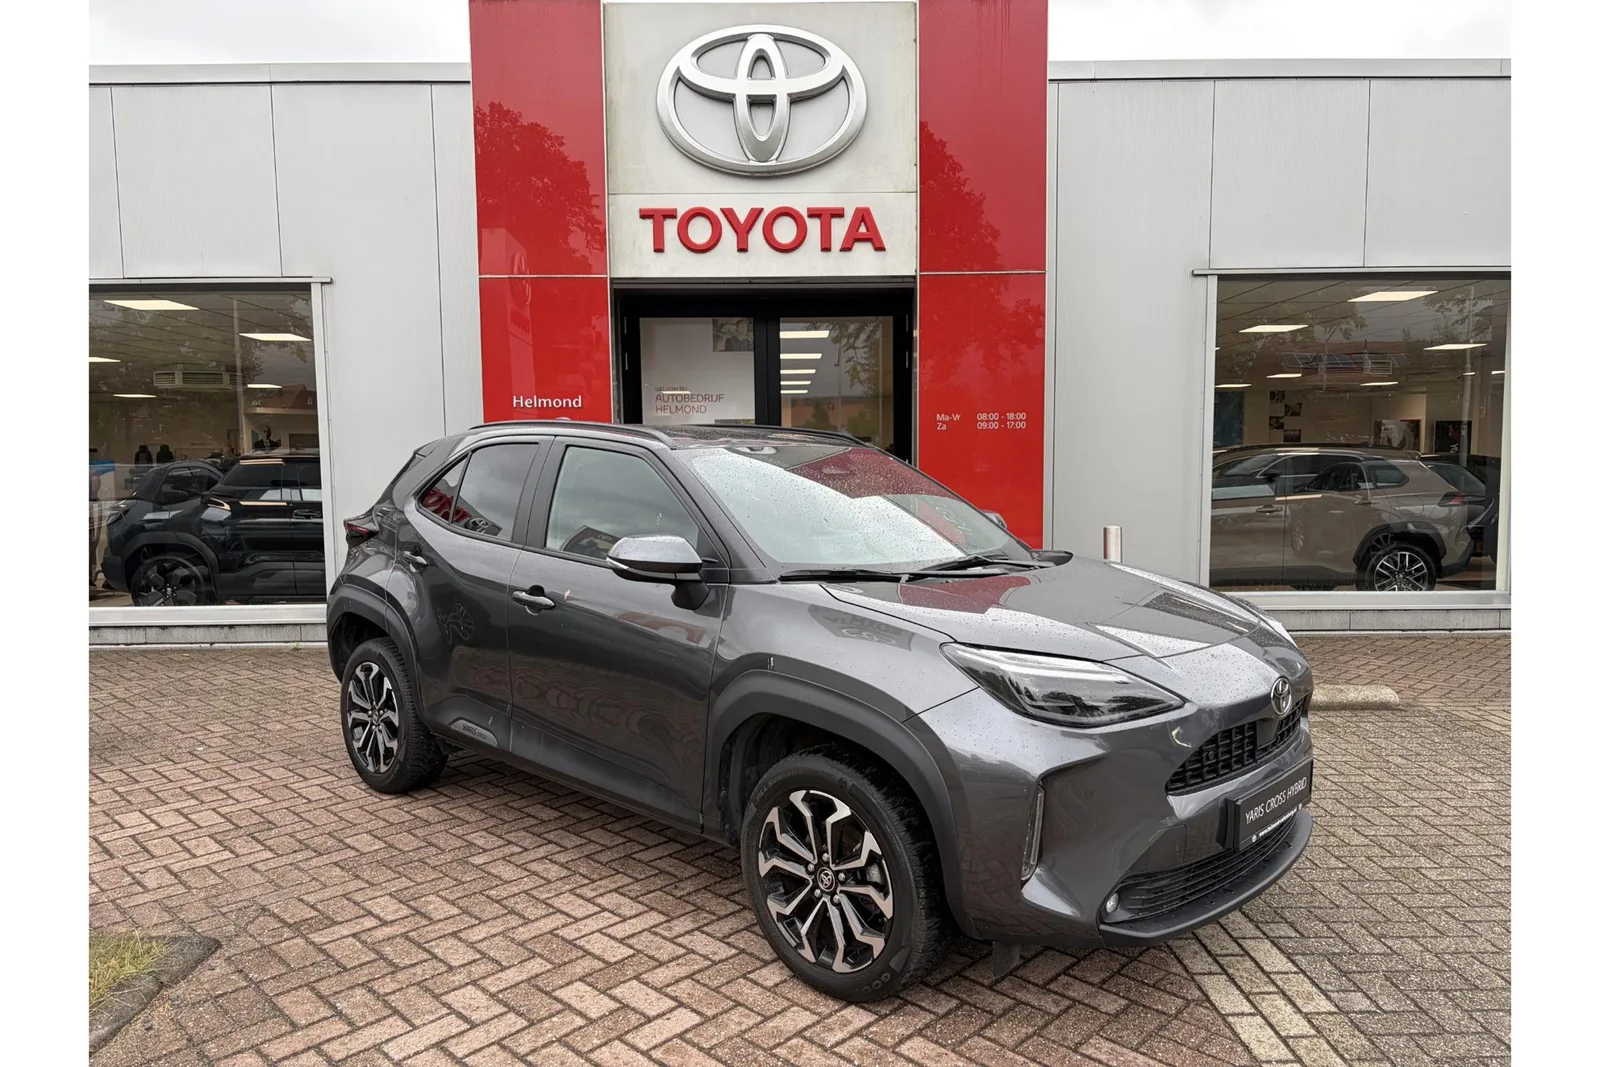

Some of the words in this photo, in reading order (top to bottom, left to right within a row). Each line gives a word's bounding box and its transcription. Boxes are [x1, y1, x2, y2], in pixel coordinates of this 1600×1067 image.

[639, 206, 887, 253] TOYOTA
[513, 395, 582, 408] Helmond
[655, 393, 725, 403] AUTOBEDRIJF
[655, 404, 707, 414] HELMOND
[936, 413, 961, 421] Ma-Vr
[1006, 412, 1027, 420] 18:00
[1006, 421, 1027, 429] 17:00
[1245, 804, 1265, 825] YARIS
[1265, 790, 1287, 813] CROSS
[1287, 777, 1307, 799] HYBRID
